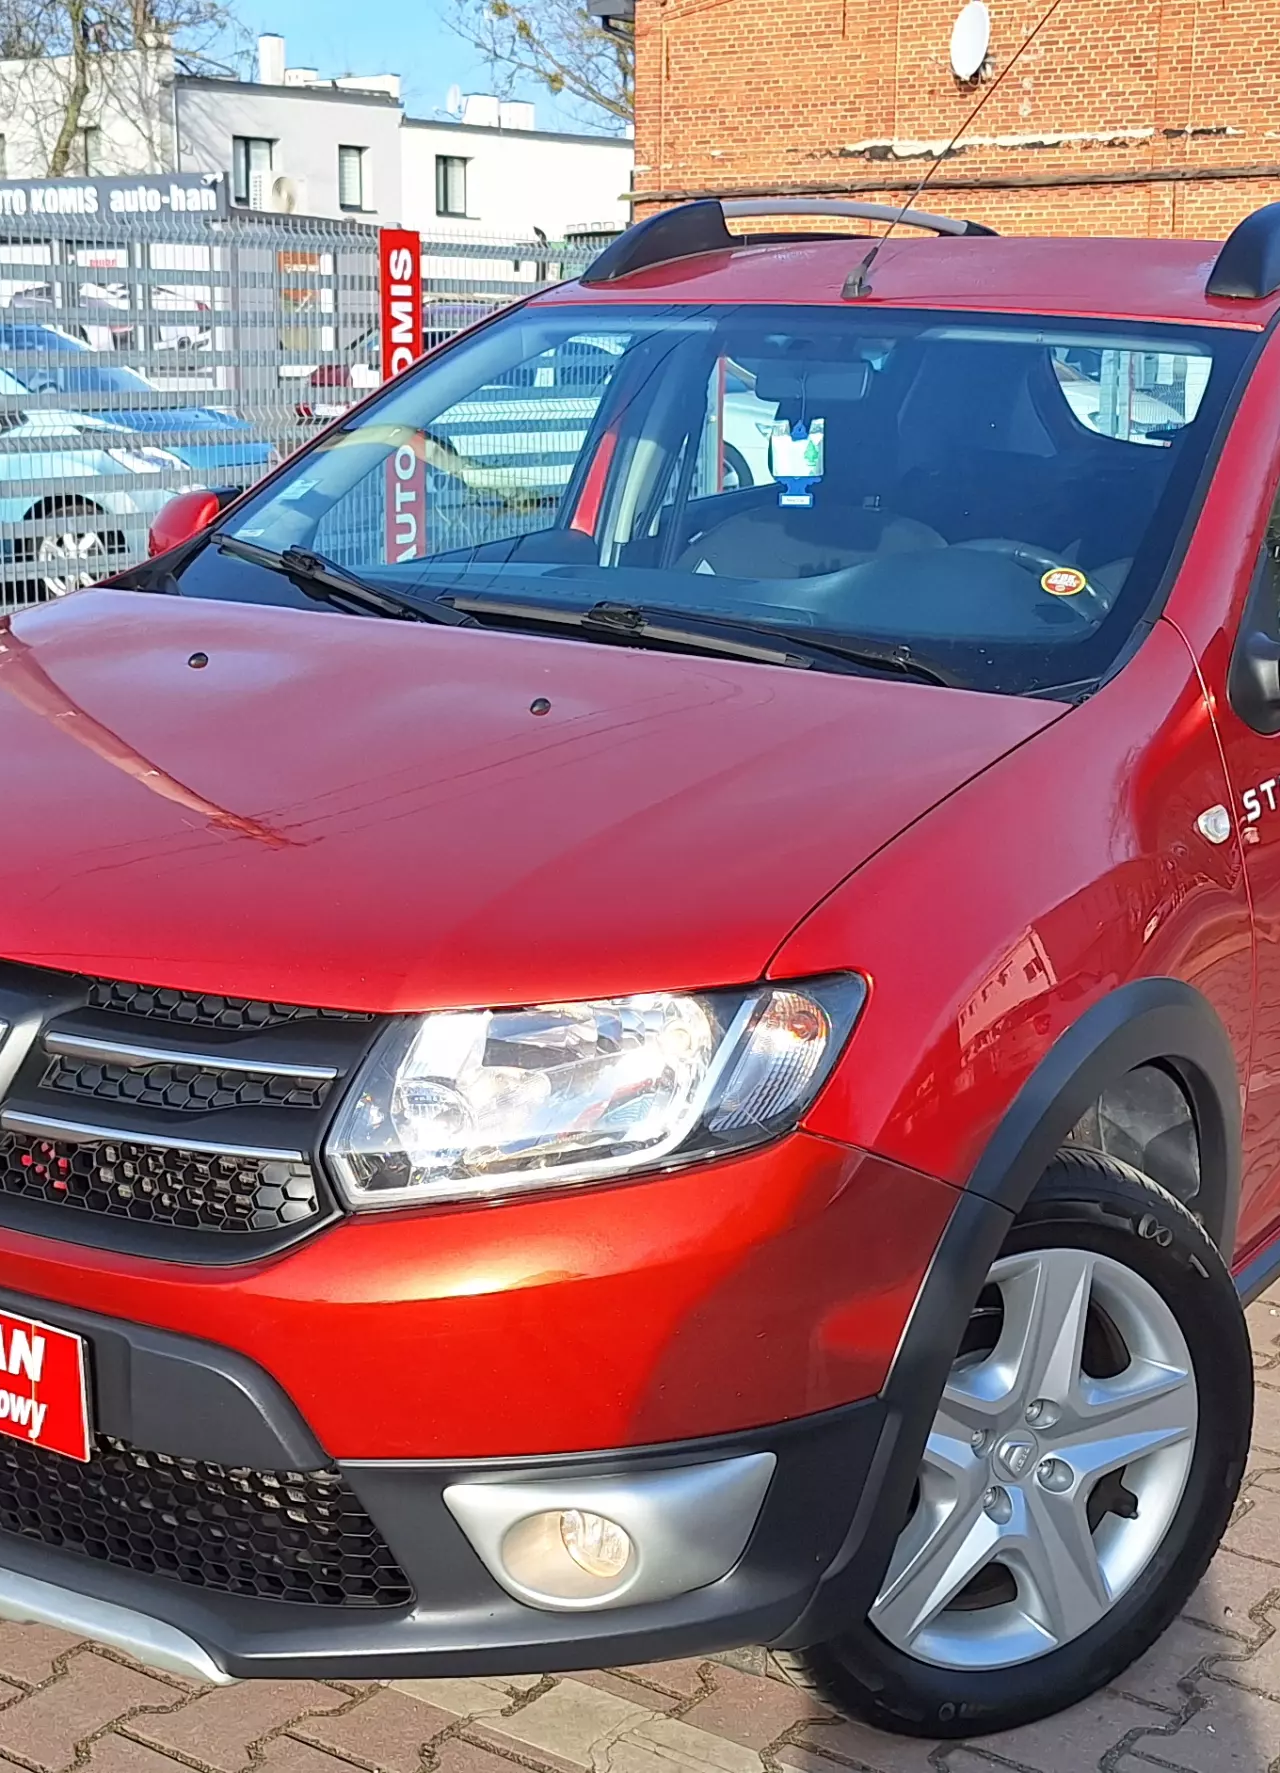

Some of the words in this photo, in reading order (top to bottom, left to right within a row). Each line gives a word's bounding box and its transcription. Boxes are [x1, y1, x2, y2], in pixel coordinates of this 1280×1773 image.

[30, 186, 98, 214] KOMIS
[109, 184, 218, 213] auto-han
[389, 247, 414, 377] OMIS
